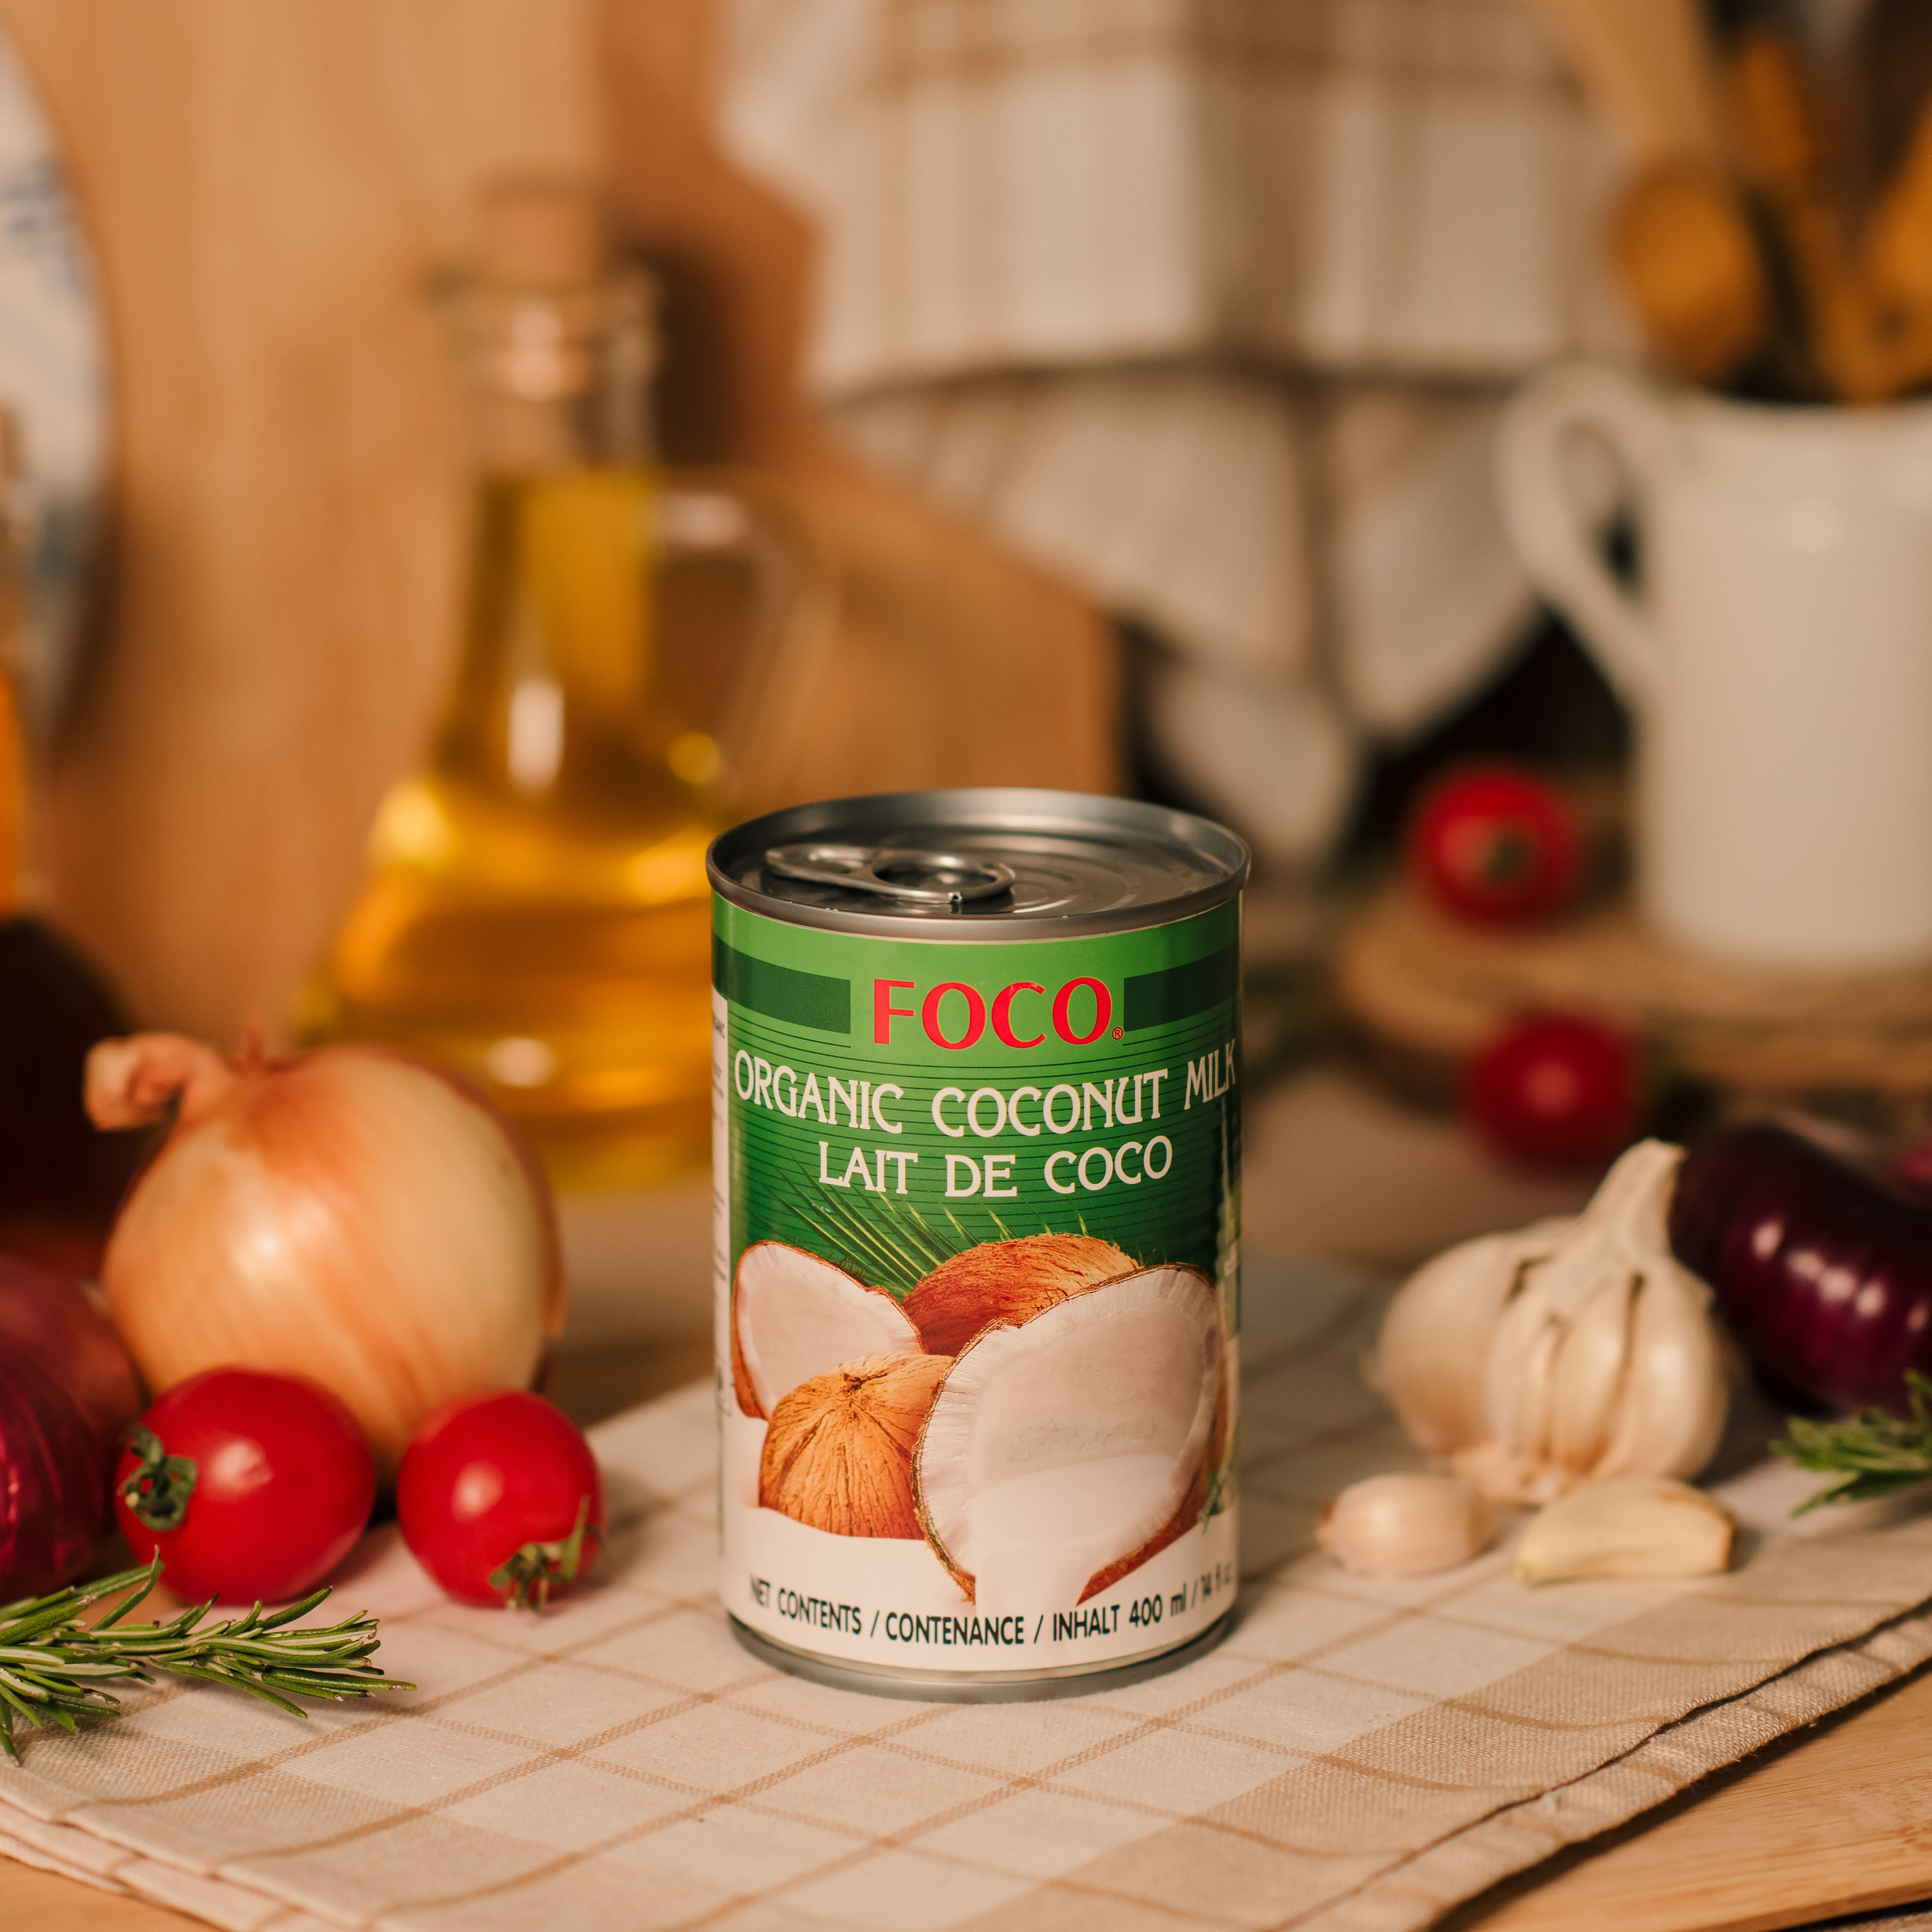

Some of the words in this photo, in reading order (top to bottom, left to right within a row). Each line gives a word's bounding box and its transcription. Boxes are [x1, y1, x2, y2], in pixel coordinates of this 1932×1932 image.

[734, 1049, 905, 1135] ORGANIC
[931, 1068, 1169, 1139] COCONUT
[1184, 1038, 1236, 1110] MILK
[818, 1140, 918, 1195] LAIT
[944, 1153, 1018, 1198] DE
[1044, 1135, 1173, 1195] COCO
[749, 1574, 771, 1608] NET
[777, 1586, 863, 1636] CONTENTS
[884, 1611, 1025, 1646] CONTENANCE
[1052, 1603, 1122, 1642] INHALT
[1128, 1593, 1164, 1629] 400
[1170, 1582, 1187, 1617] ml
